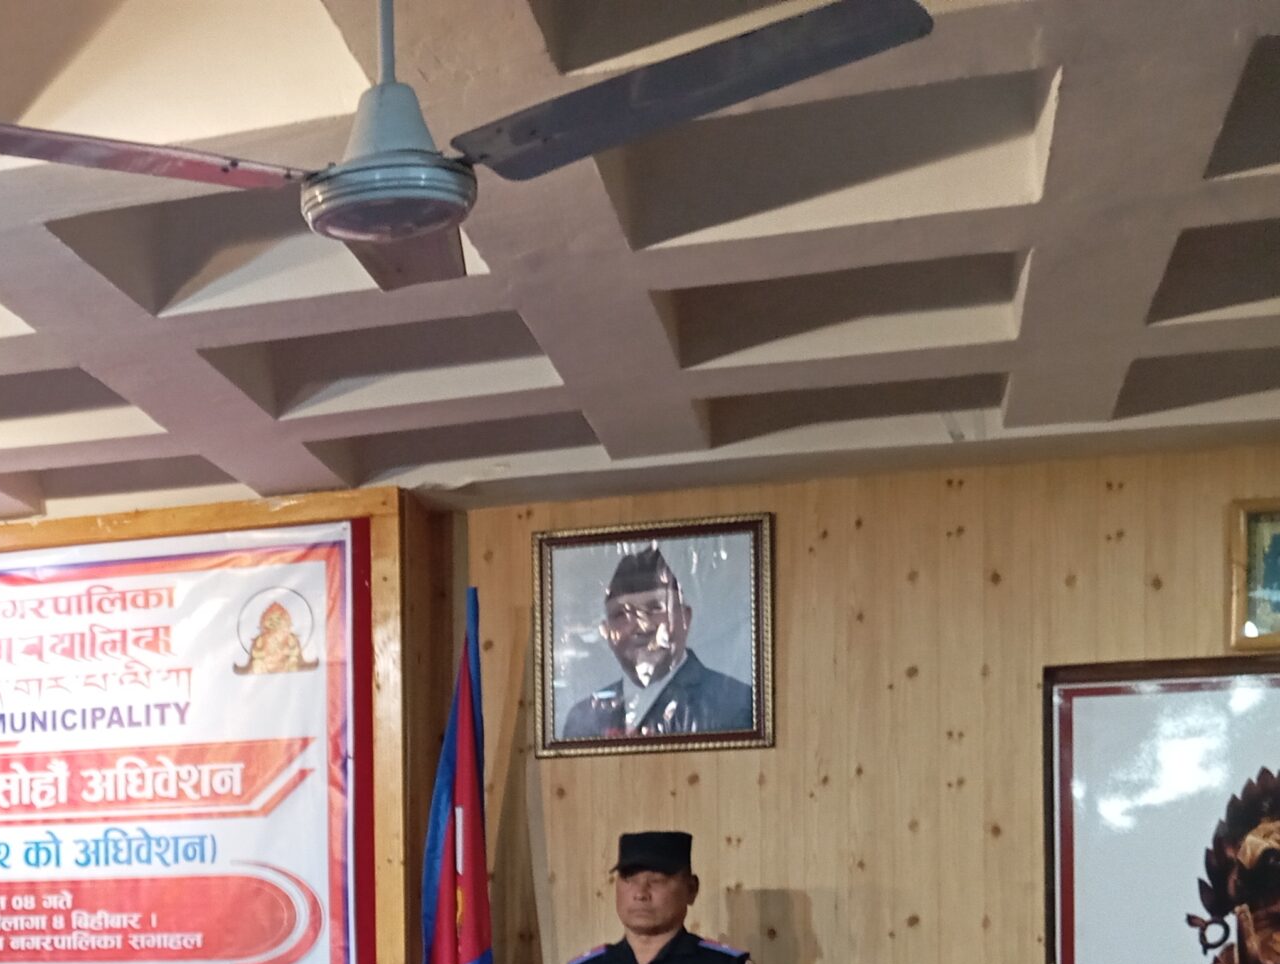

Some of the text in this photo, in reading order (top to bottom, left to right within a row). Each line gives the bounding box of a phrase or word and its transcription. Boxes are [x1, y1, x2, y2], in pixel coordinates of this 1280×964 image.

[80, 755, 246, 802] अधिवेशन
[23, 830, 63, 869] को
[73, 827, 218, 868] अधिवेशन)
[11, 894, 36, 911] ०४
[9, 931, 123, 952] नगरपालिका
